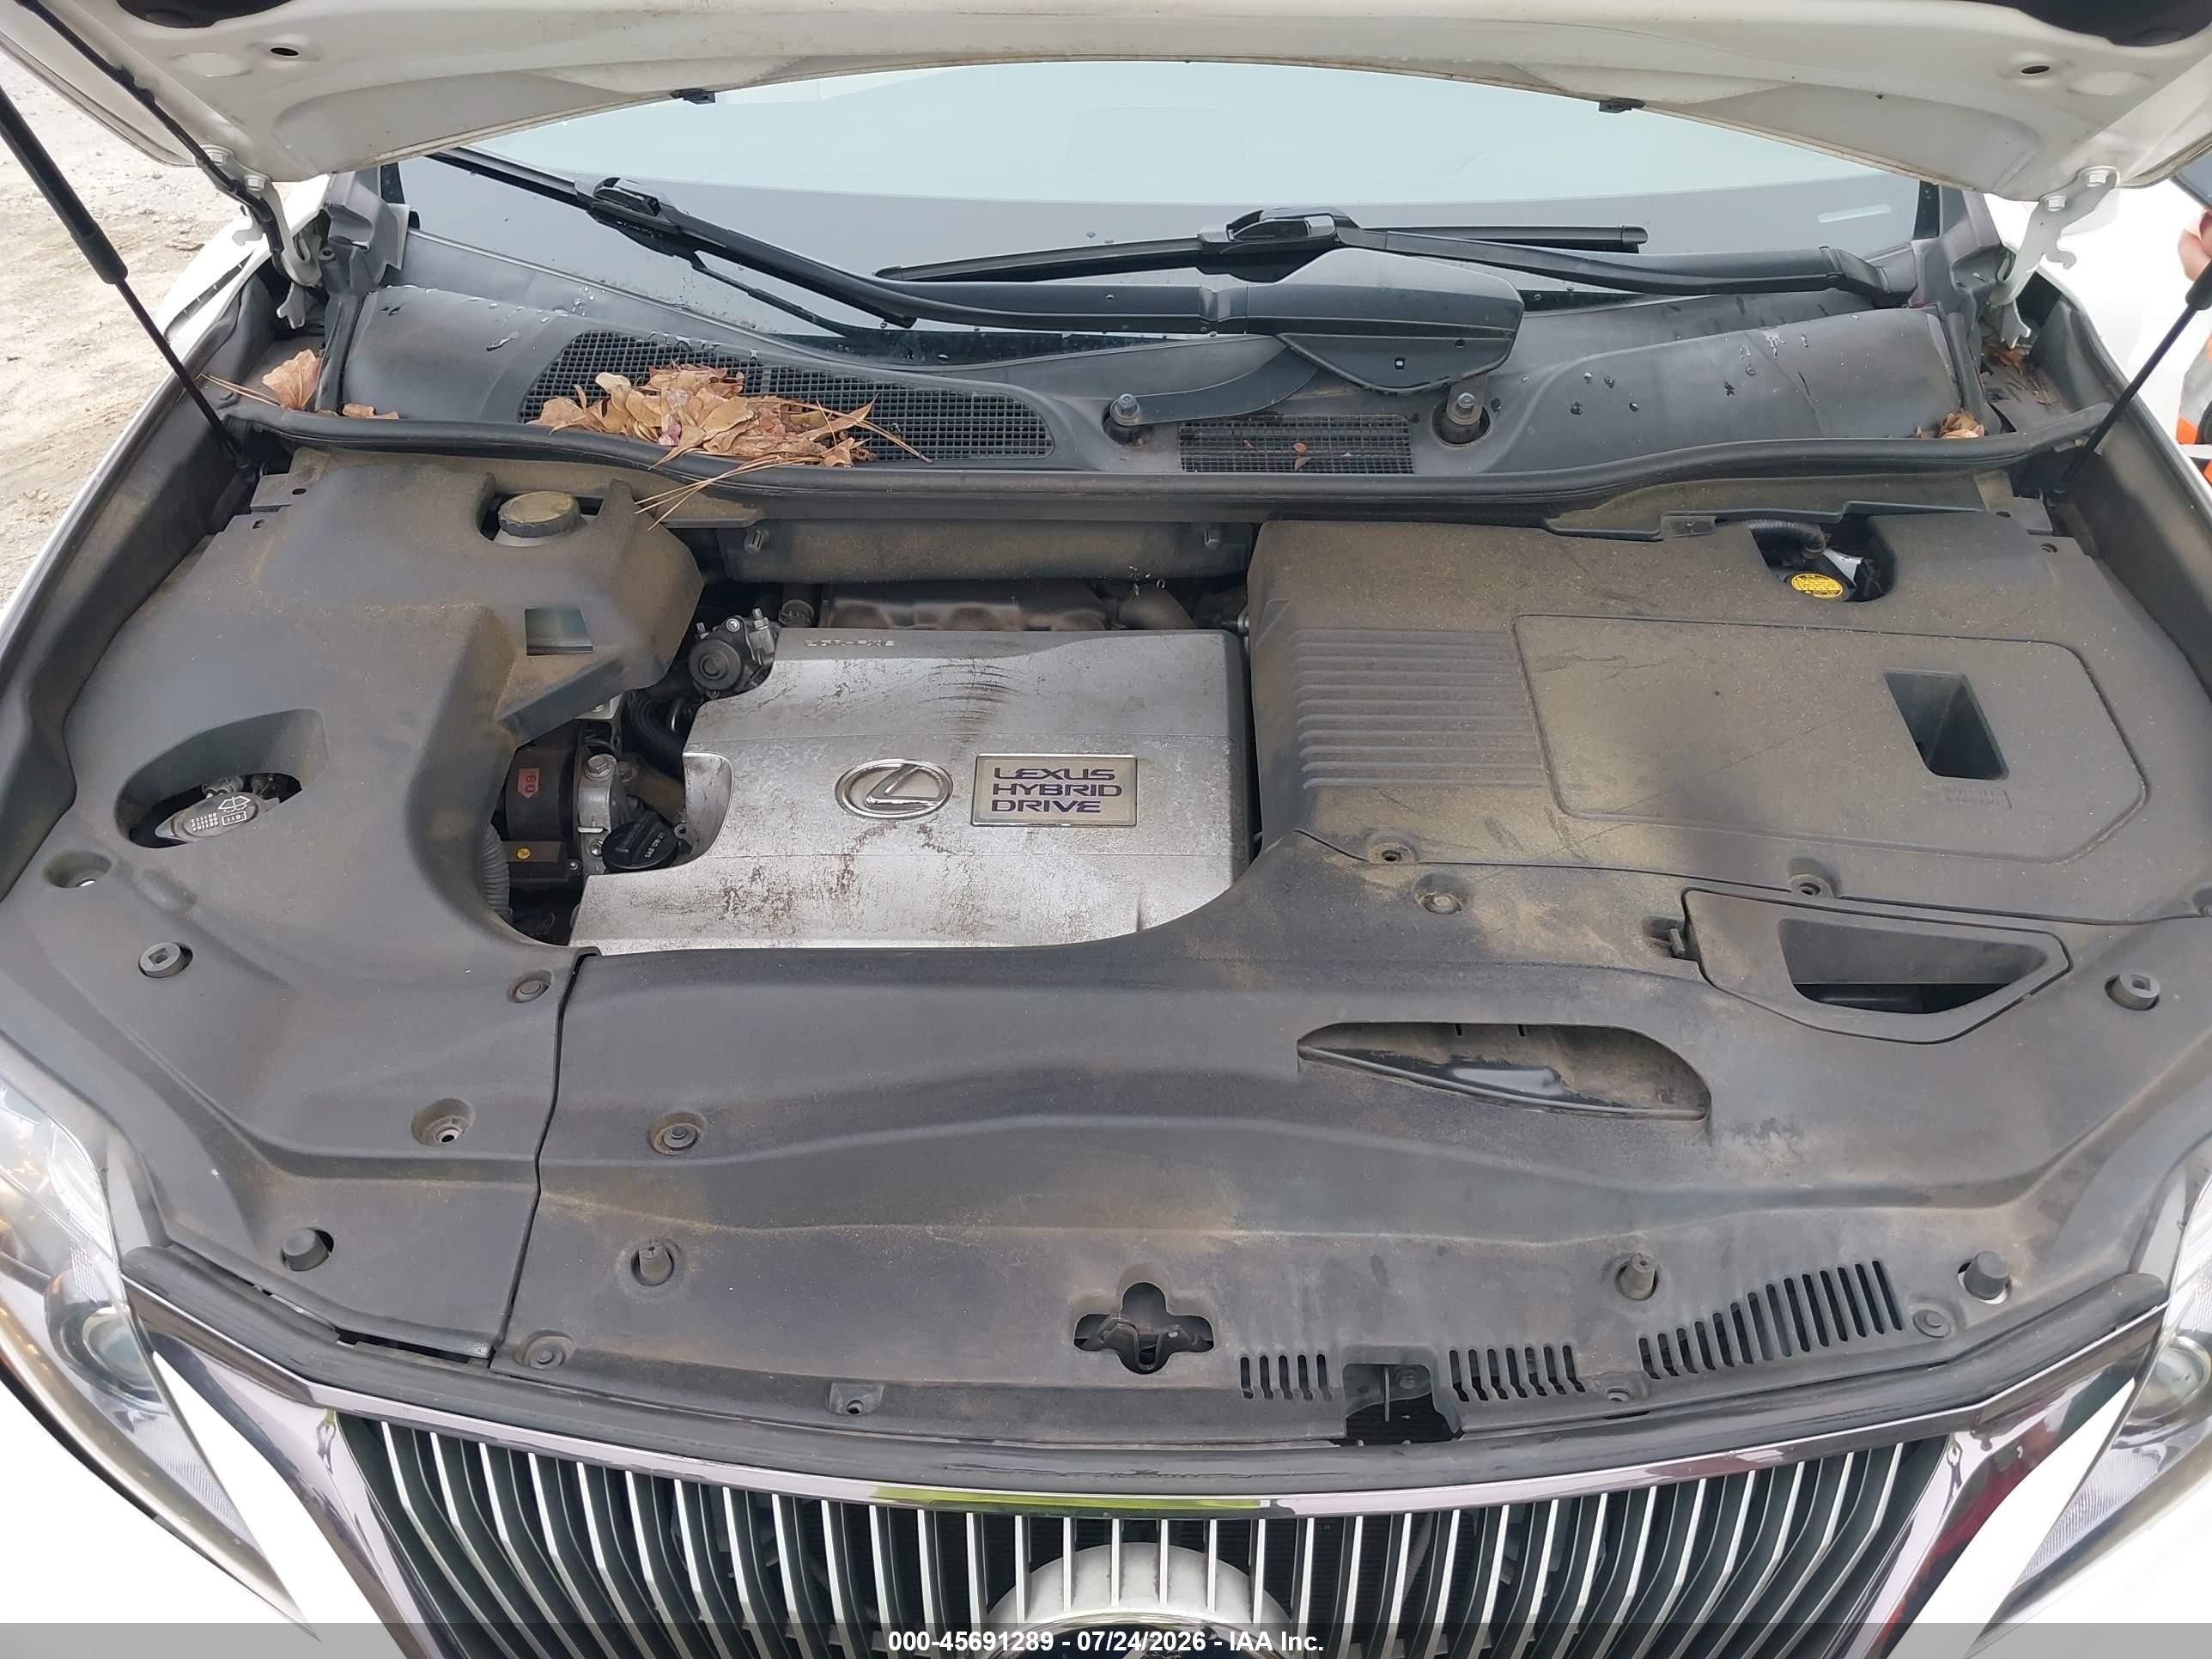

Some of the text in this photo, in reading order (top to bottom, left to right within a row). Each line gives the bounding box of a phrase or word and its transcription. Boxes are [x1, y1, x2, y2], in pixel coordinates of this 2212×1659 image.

[994, 767, 1115, 781] LEXUS
[993, 783, 1122, 797] HYBRID
[991, 799, 1102, 813] DRIVE
